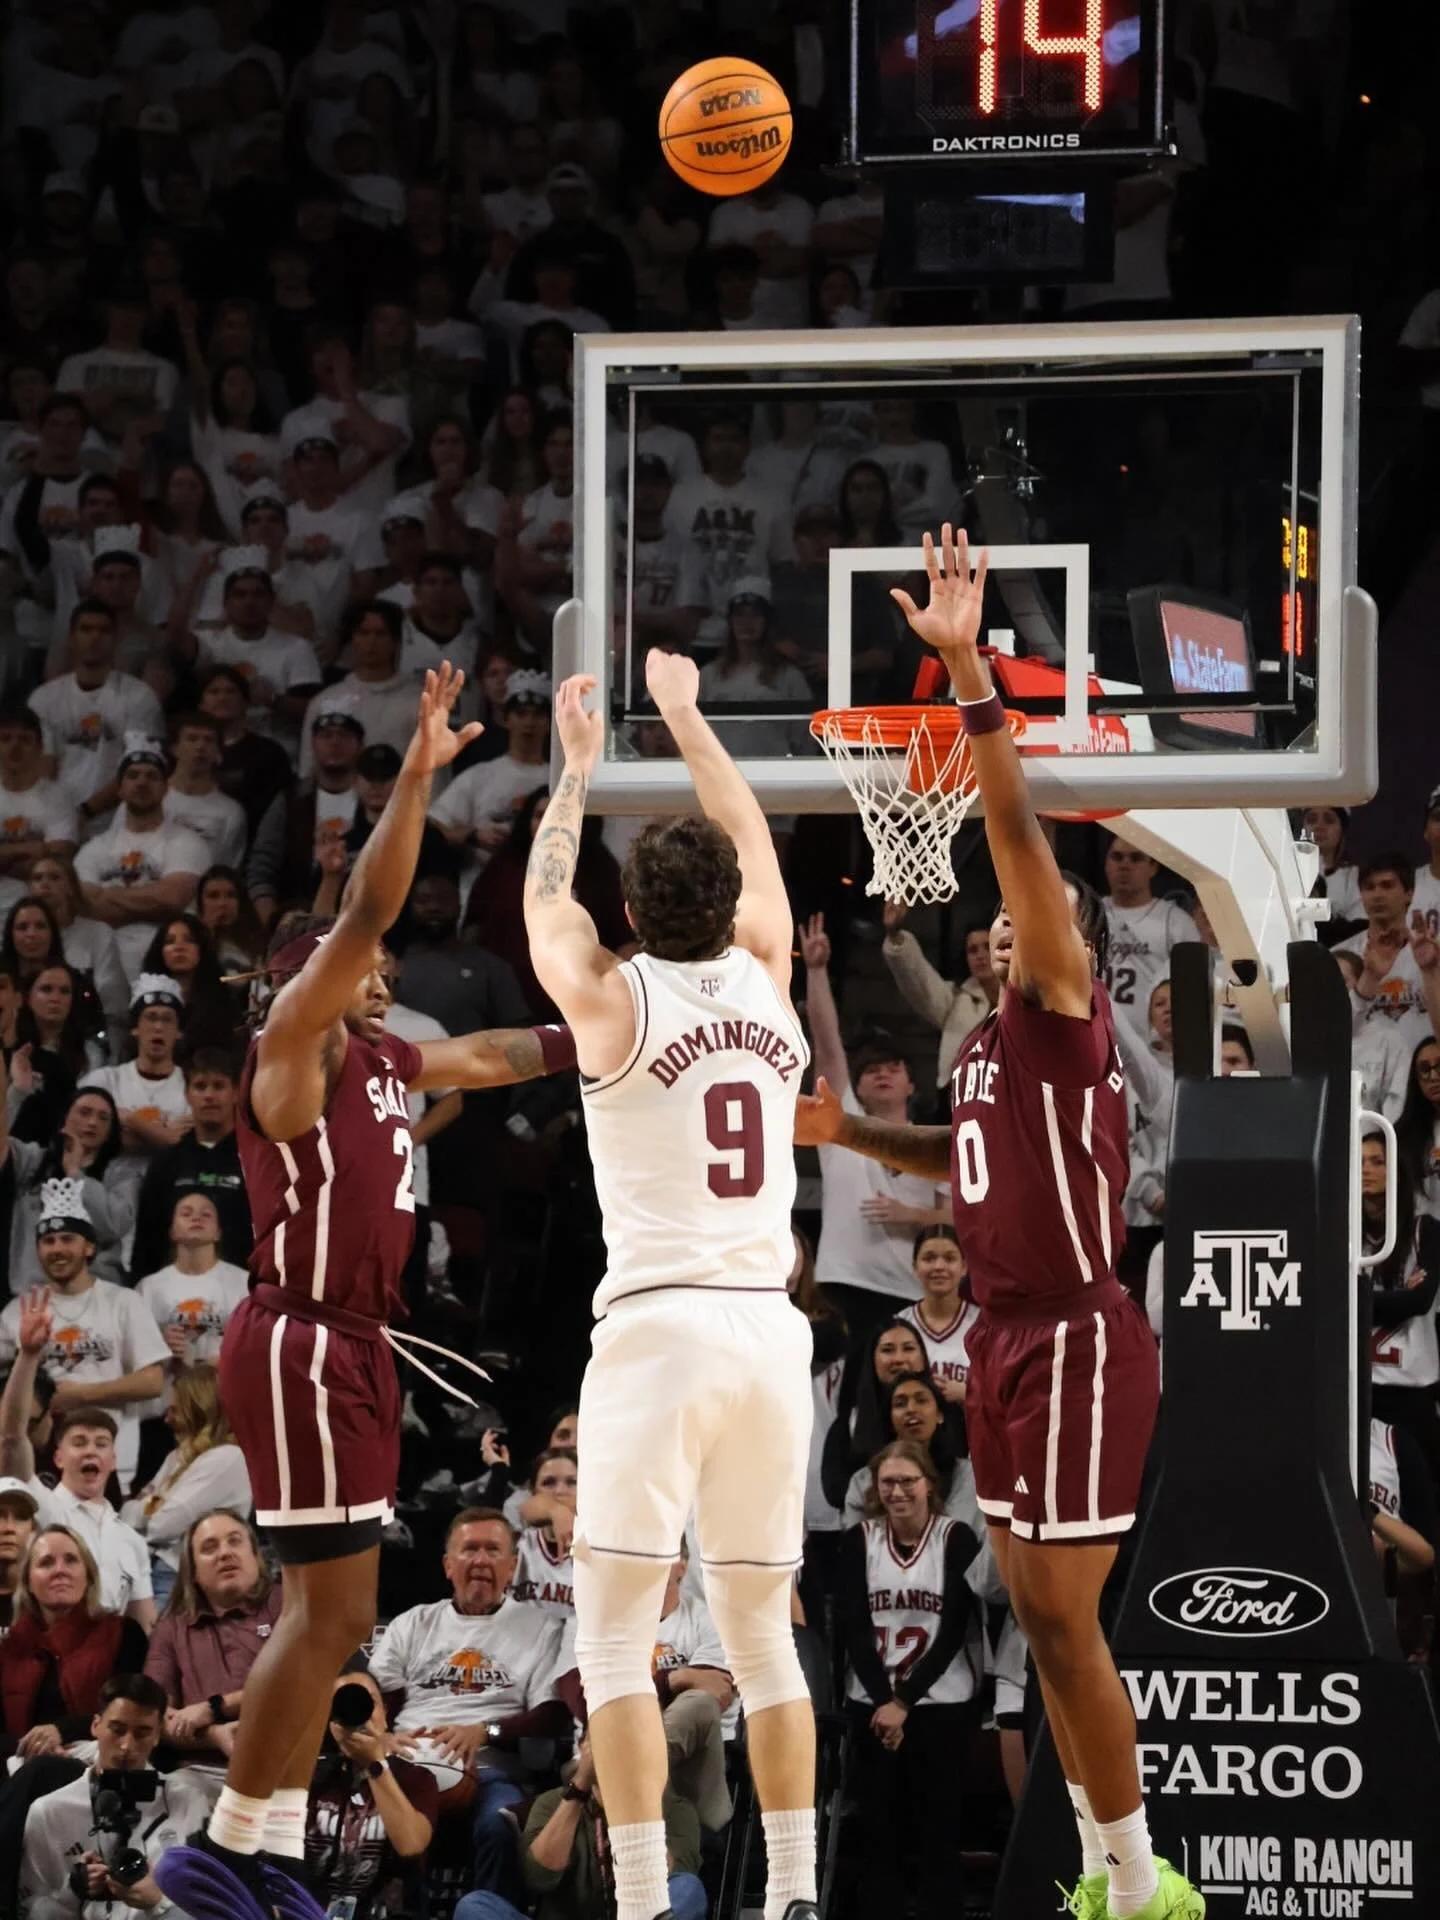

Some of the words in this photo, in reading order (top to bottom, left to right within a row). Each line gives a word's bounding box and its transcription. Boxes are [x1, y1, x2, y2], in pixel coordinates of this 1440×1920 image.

[979, 0, 1101, 114] 14
[696, 125, 782, 158] Wilson
[932, 133, 1081, 152] DAKTRONICS
[648, 1020, 800, 1090] DOMINGUEZ
[952, 1060, 999, 1107] TATE
[703, 1081, 764, 1198] 9
[956, 1119, 990, 1204] 0
[393, 1127, 415, 1213] 2
[1179, 1575, 1297, 1627] Ford
[1120, 1669, 1362, 1725] WELLS
[1135, 1743, 1364, 1800] FARGO
[1200, 1835, 1282, 1883] KING
[1294, 1837, 1413, 1886] RANCH
[1245, 1886, 1278, 1916] AG
[1282, 1887, 1302, 1917] &
[1304, 1887, 1366, 1919] TURF
